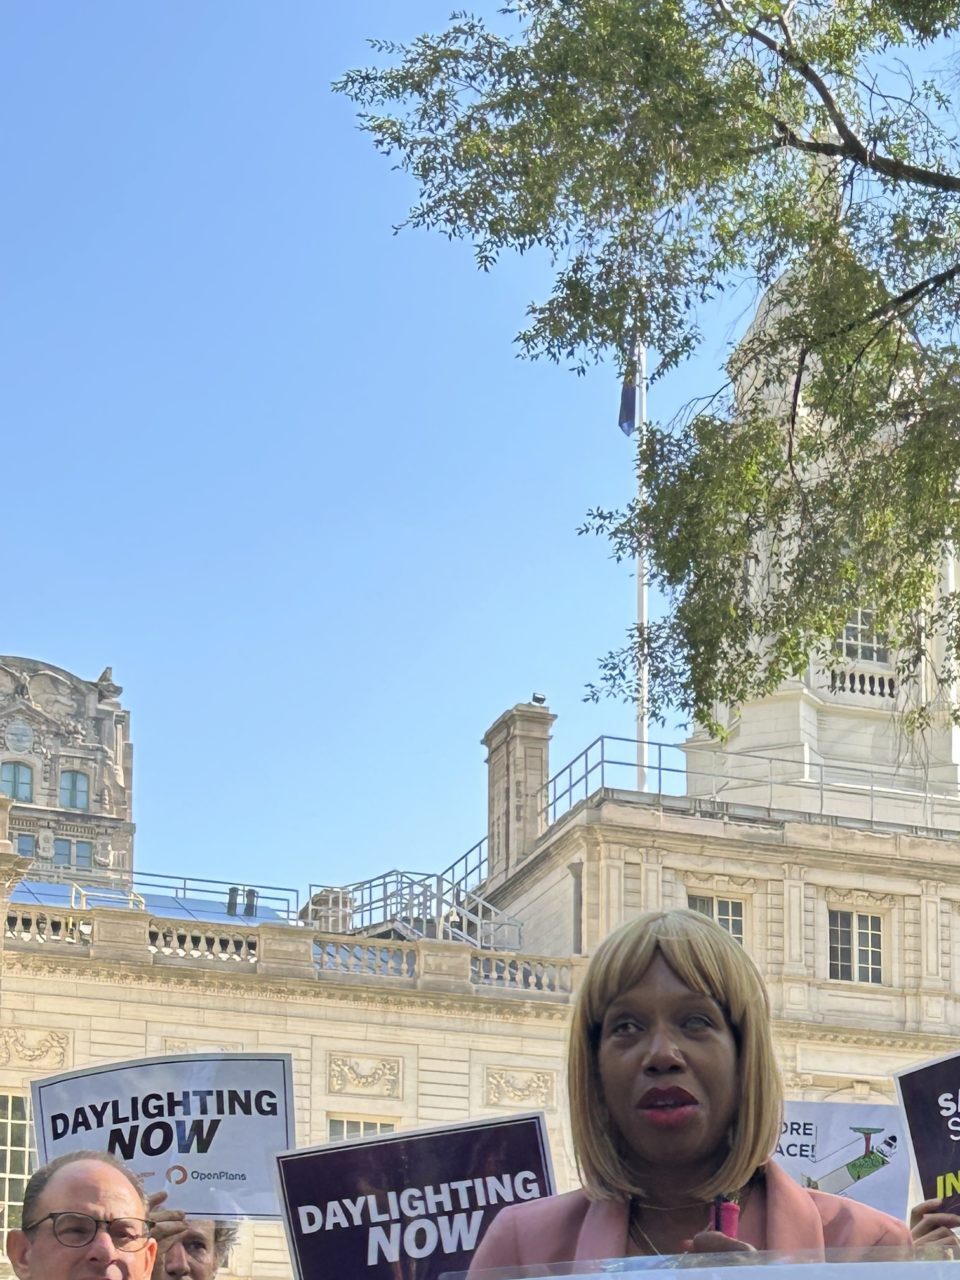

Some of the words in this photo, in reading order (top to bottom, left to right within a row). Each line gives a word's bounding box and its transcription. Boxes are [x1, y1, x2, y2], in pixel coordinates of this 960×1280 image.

[51, 1089, 278, 1140] DAYLIGHTING
[106, 1119, 221, 1160] NOW
[191, 1170, 246, 1182] OpenPlans
[298, 1170, 540, 1234] DAYLIGHTING
[367, 1209, 485, 1266] NOW
